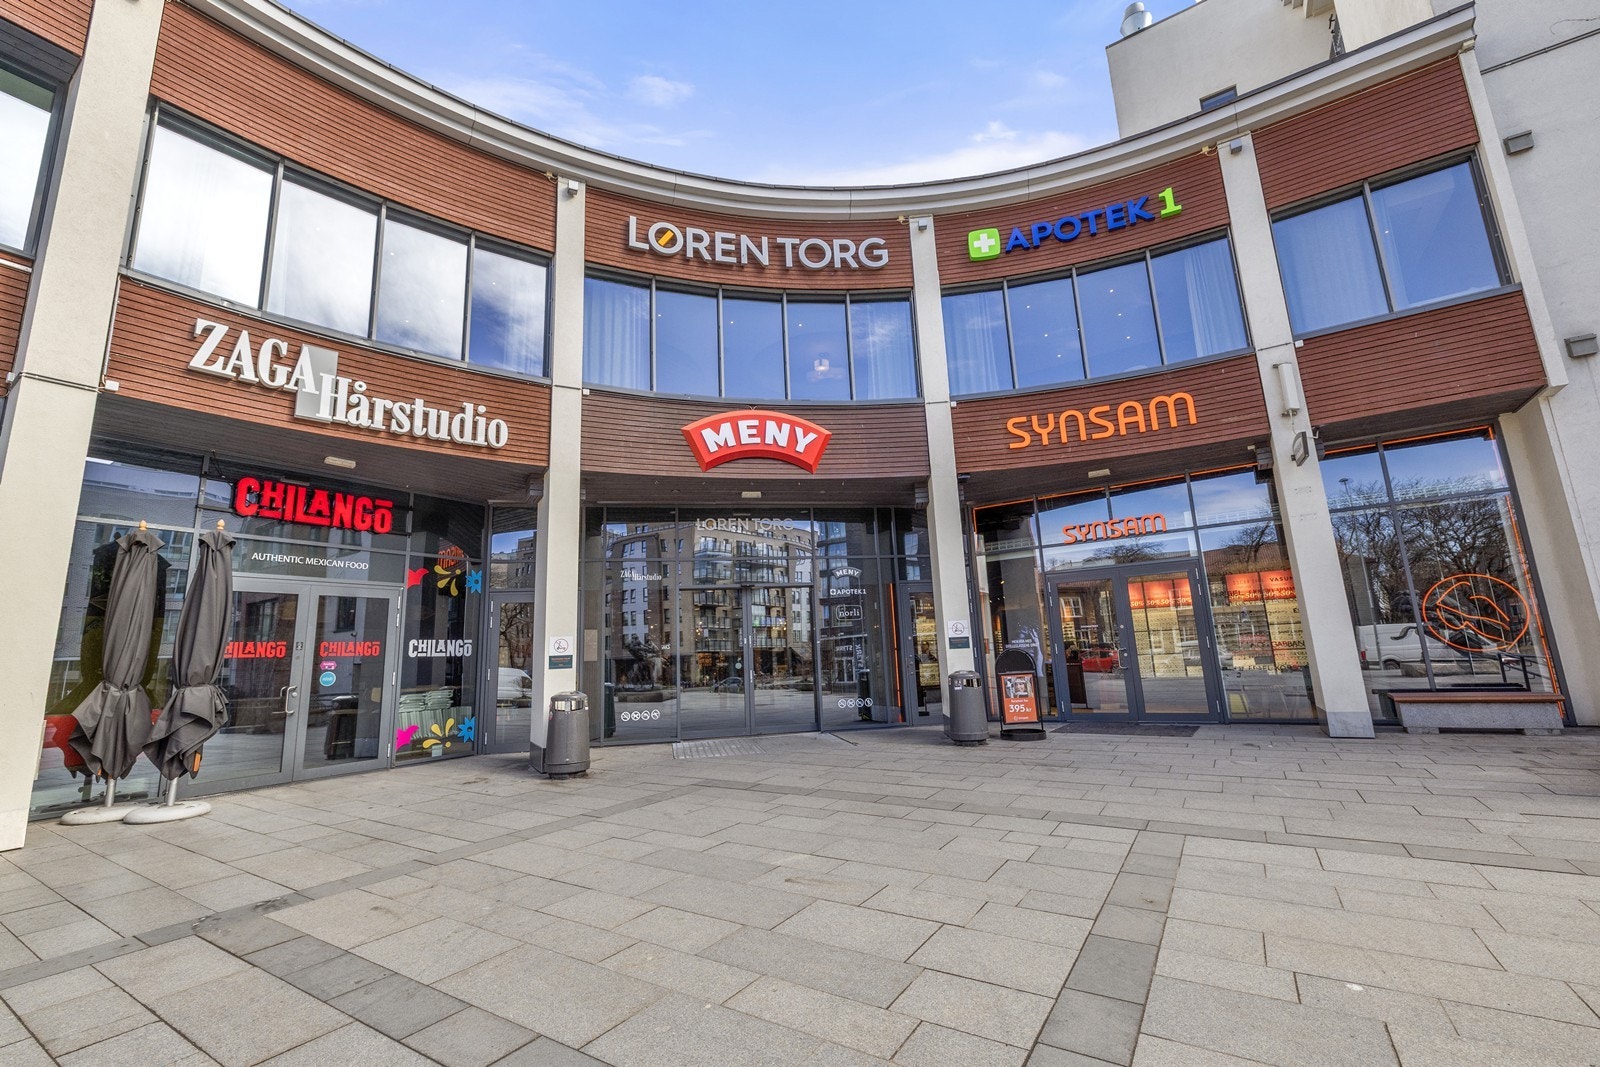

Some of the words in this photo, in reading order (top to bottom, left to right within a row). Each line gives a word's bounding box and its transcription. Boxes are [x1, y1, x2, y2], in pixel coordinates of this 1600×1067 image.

[1005, 195, 1156, 254] APOTEK
[1158, 187, 1182, 219] 1
[628, 215, 769, 267] LOREN
[777, 237, 889, 269] TORG
[188, 318, 319, 394] ZAGA
[316, 372, 509, 449] Hårstudio
[701, 419, 819, 454] MENY
[1007, 392, 1199, 450] SYNSAM
[1062, 513, 1167, 544] SYNSAM
[251, 552, 304, 564] AUTHENTIC
[305, 557, 344, 568] MEXICAN
[345, 561, 369, 570] FOOD
[835, 568, 859, 577] MENY
[839, 608, 860, 617] norli
[1009, 704, 1026, 713] 395
